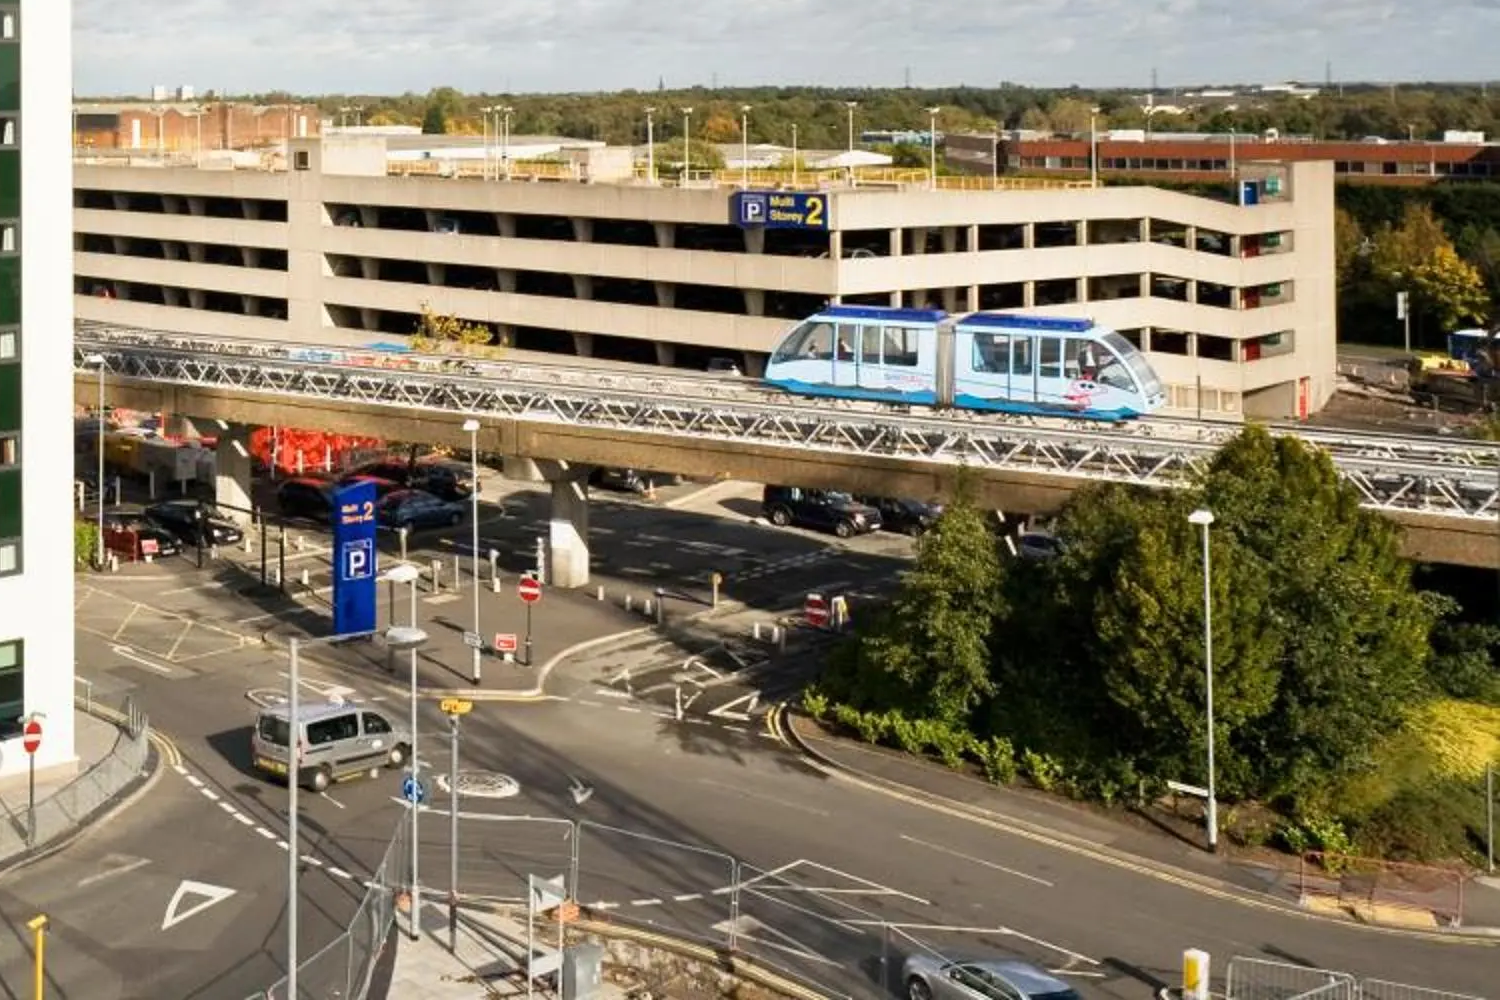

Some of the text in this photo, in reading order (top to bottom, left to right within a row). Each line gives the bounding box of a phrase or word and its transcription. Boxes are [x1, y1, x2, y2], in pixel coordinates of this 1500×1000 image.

[748, 203, 760, 220] P
[806, 197, 823, 224] 2
[363, 501, 374, 522] 2
[350, 551, 365, 577] P
